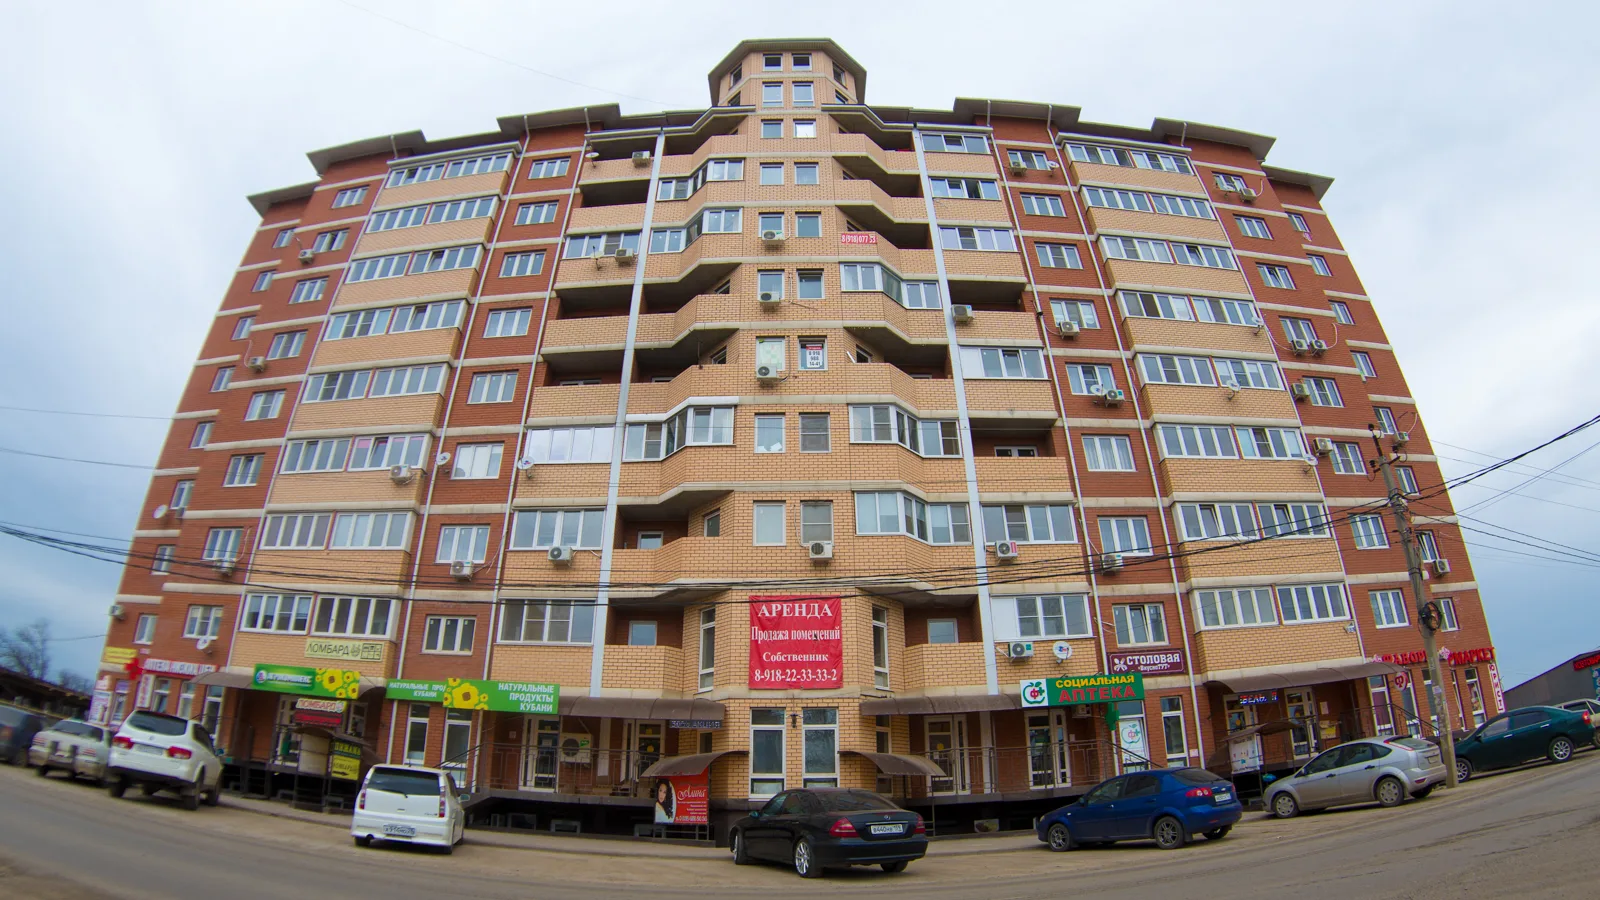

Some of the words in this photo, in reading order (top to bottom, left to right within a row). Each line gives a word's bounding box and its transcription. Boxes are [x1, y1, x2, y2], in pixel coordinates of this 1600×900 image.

[758, 603, 833, 620] АРЕНДА
[751, 626, 789, 644] Продажа
[791, 626, 840, 641] помещений
[306, 643, 349, 656] ЛОМБАРД
[762, 651, 829, 662] Собственник
[754, 668, 837, 682] 8-918-22-33-33-2
[388, 682, 429, 691] НАТУРАЛЬНЫЕ
[1055, 675, 1135, 688] СОЦИАЛЬНАЯ
[413, 690, 437, 698] КУБАНИ
[498, 683, 554, 693] НАТУРАЛЬНЫЕ
[1058, 685, 1136, 702] АПТЕКА
[510, 693, 554, 703] ПРОДУКТЫ
[520, 703, 553, 712] КУБАНИ
